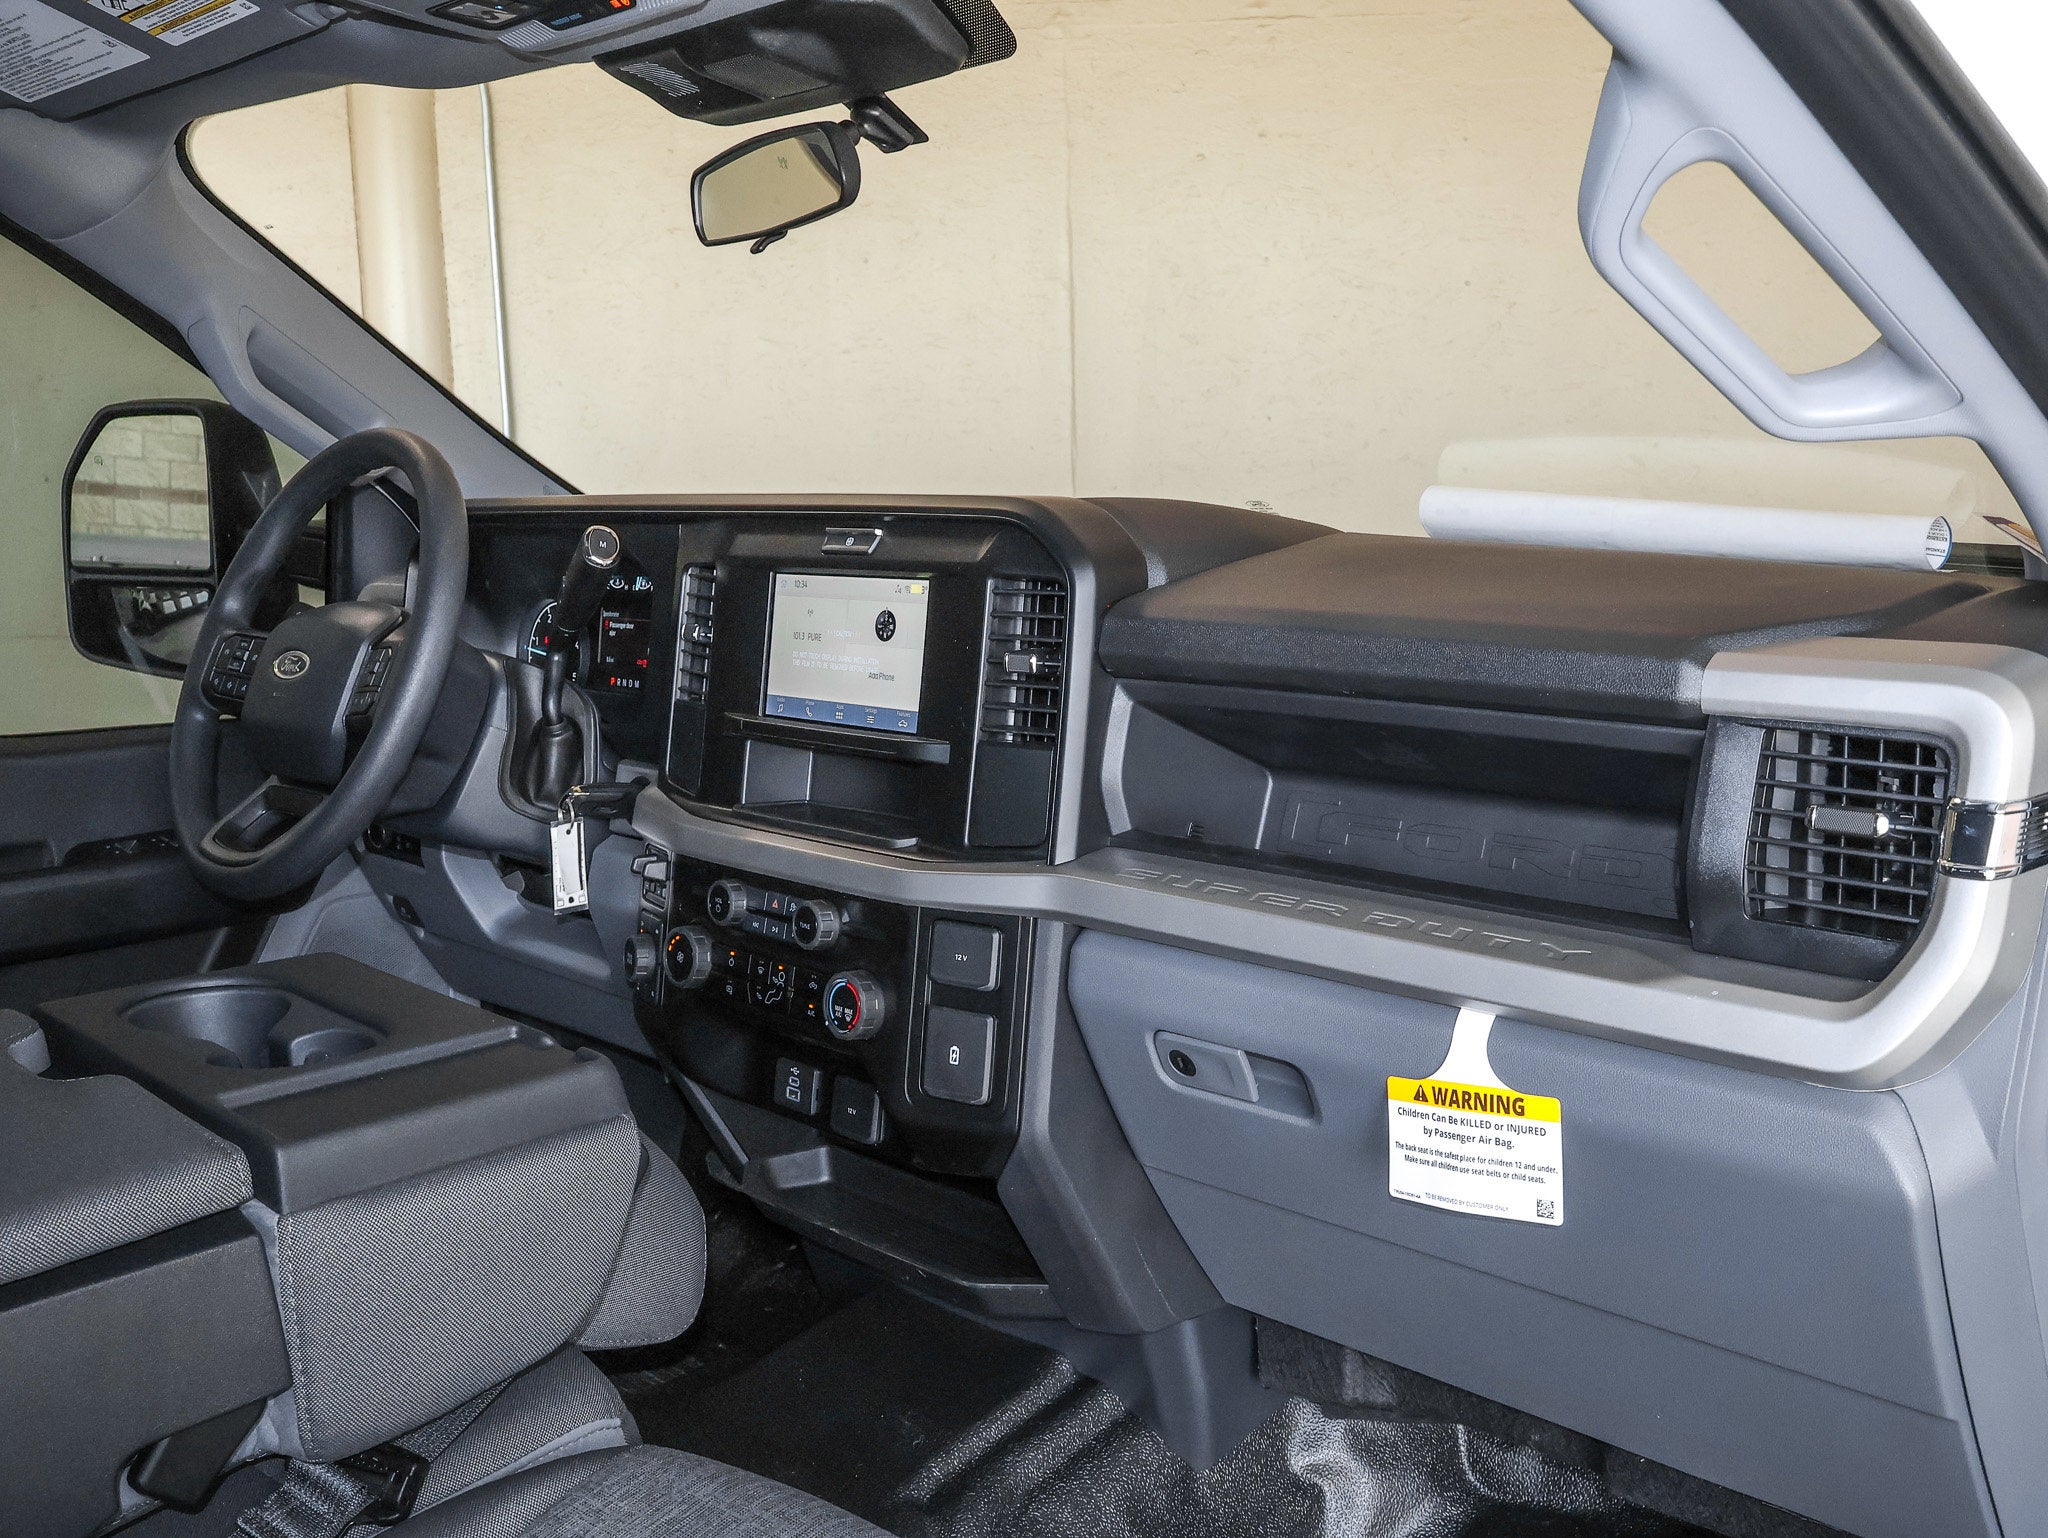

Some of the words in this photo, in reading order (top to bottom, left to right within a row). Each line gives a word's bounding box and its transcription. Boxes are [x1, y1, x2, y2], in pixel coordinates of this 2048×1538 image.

[794, 580, 808, 588] 10:34
[547, 614, 552, 624] 2
[808, 633, 822, 642] PURE
[574, 641, 580, 650] 4
[610, 677, 616, 686] P
[616, 678, 622, 687] R
[622, 679, 627, 687] N
[634, 680, 640, 689] M
[868, 673, 879, 681] Add
[879, 673, 895, 682] Phone
[1117, 867, 1349, 918] SUPER
[1362, 910, 1593, 962] DUTY
[800, 921, 811, 930] TUNE
[807, 1009, 816, 1017] A/C
[834, 1004, 843, 1012] MAX
[844, 1007, 854, 1015] MAX
[1432, 1086, 1525, 1117] WARNING
[1398, 1106, 1430, 1120] Children
[1432, 1112, 1447, 1123] Can
[1448, 1115, 1459, 1126] Be
[1460, 1117, 1492, 1130] KILLED
[1494, 1123, 1504, 1131] or
[1506, 1123, 1547, 1136] INJURED
[1423, 1126, 1433, 1138] by
[1434, 1128, 1476, 1144] Passenger
[1478, 1135, 1492, 1145] Air
[1495, 1137, 1515, 1150] Bag.
[1395, 1141, 1404, 1150] The
[1405, 1143, 1416, 1152] back
[1418, 1146, 1429, 1155] seat
[1429, 1148, 1434, 1156] is
[1434, 1149, 1443, 1158] the
[1444, 1151, 1459, 1161] safest
[1459, 1154, 1476, 1163] place
[1477, 1156, 1487, 1164] for
[1488, 1157, 1513, 1168] children
[1515, 1161, 1522, 1169] 12
[1523, 1163, 1536, 1171] and
[1537, 1165, 1559, 1175] under.
[1404, 1154, 1419, 1164] Make
[1419, 1157, 1430, 1167] sure
[1438, 1161, 1459, 1172] children
[1459, 1167, 1470, 1175] use
[1471, 1168, 1485, 1176] seat
[1485, 1169, 1502, 1178] belts
[1511, 1172, 1527, 1182] child
[1527, 1175, 1547, 1184] seats.
[1466, 1200, 1494, 1210] CUSTOMER
[1495, 1204, 1509, 1212] ONLY
